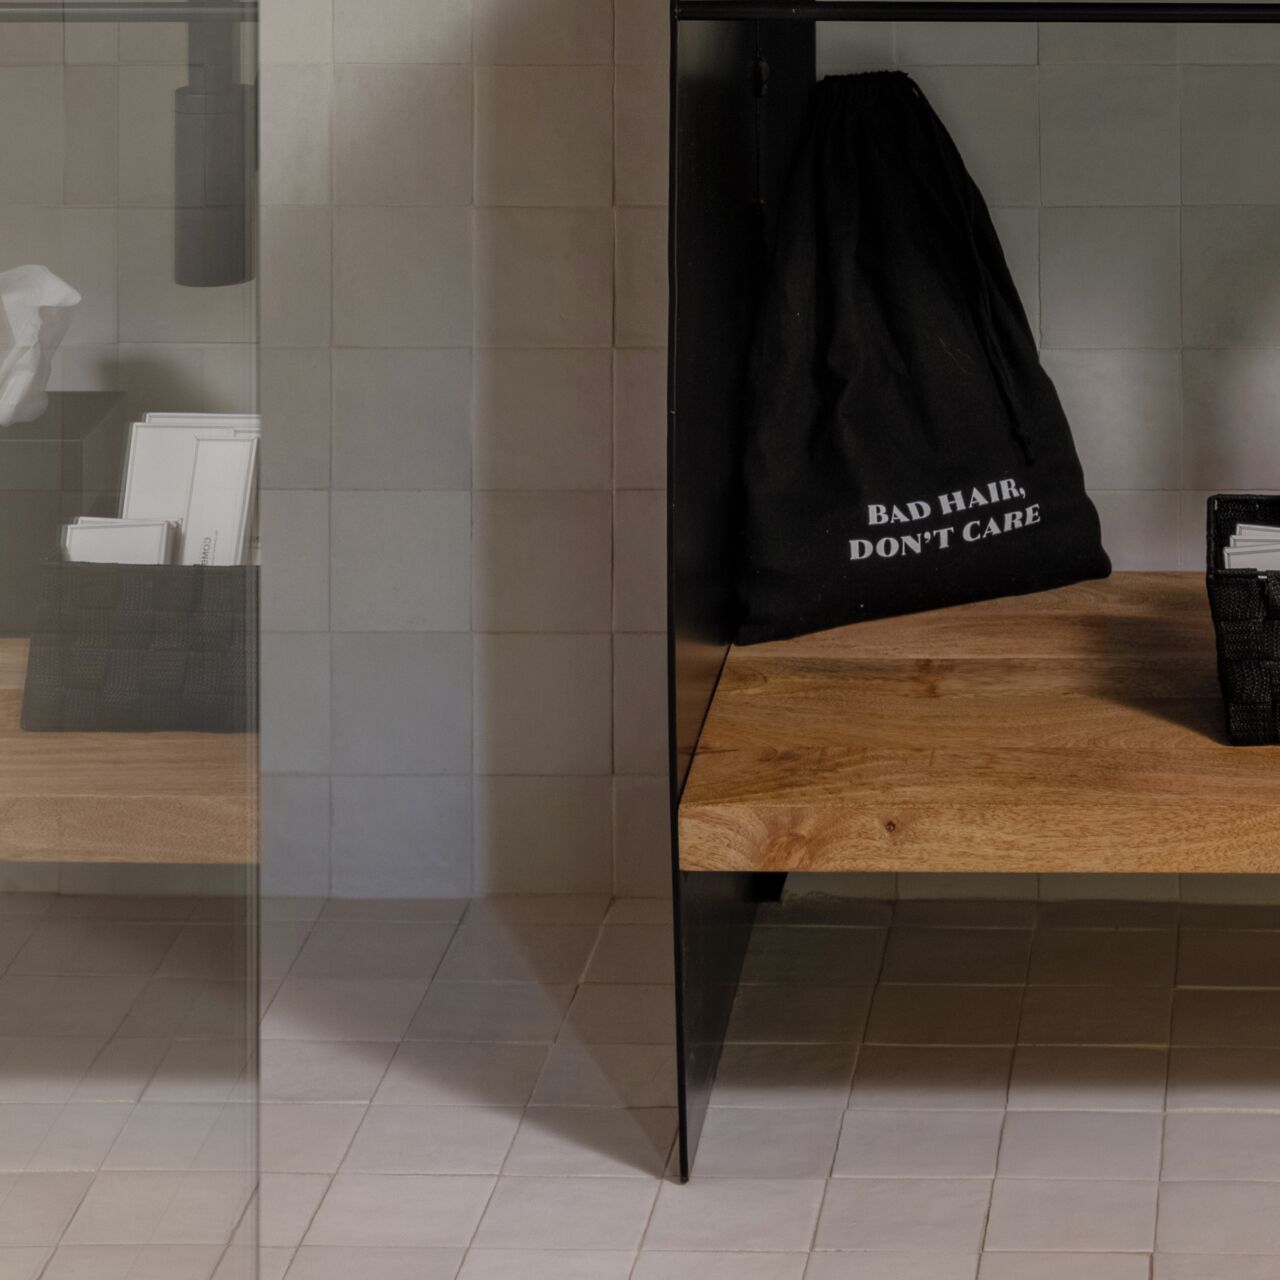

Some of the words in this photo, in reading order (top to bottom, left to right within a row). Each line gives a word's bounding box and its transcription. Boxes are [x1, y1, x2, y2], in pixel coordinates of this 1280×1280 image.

[867, 500, 932, 526] BAD
[938, 477, 1026, 515] HAIR,
[848, 526, 955, 561] DON'T
[962, 503, 1041, 543] CARE
